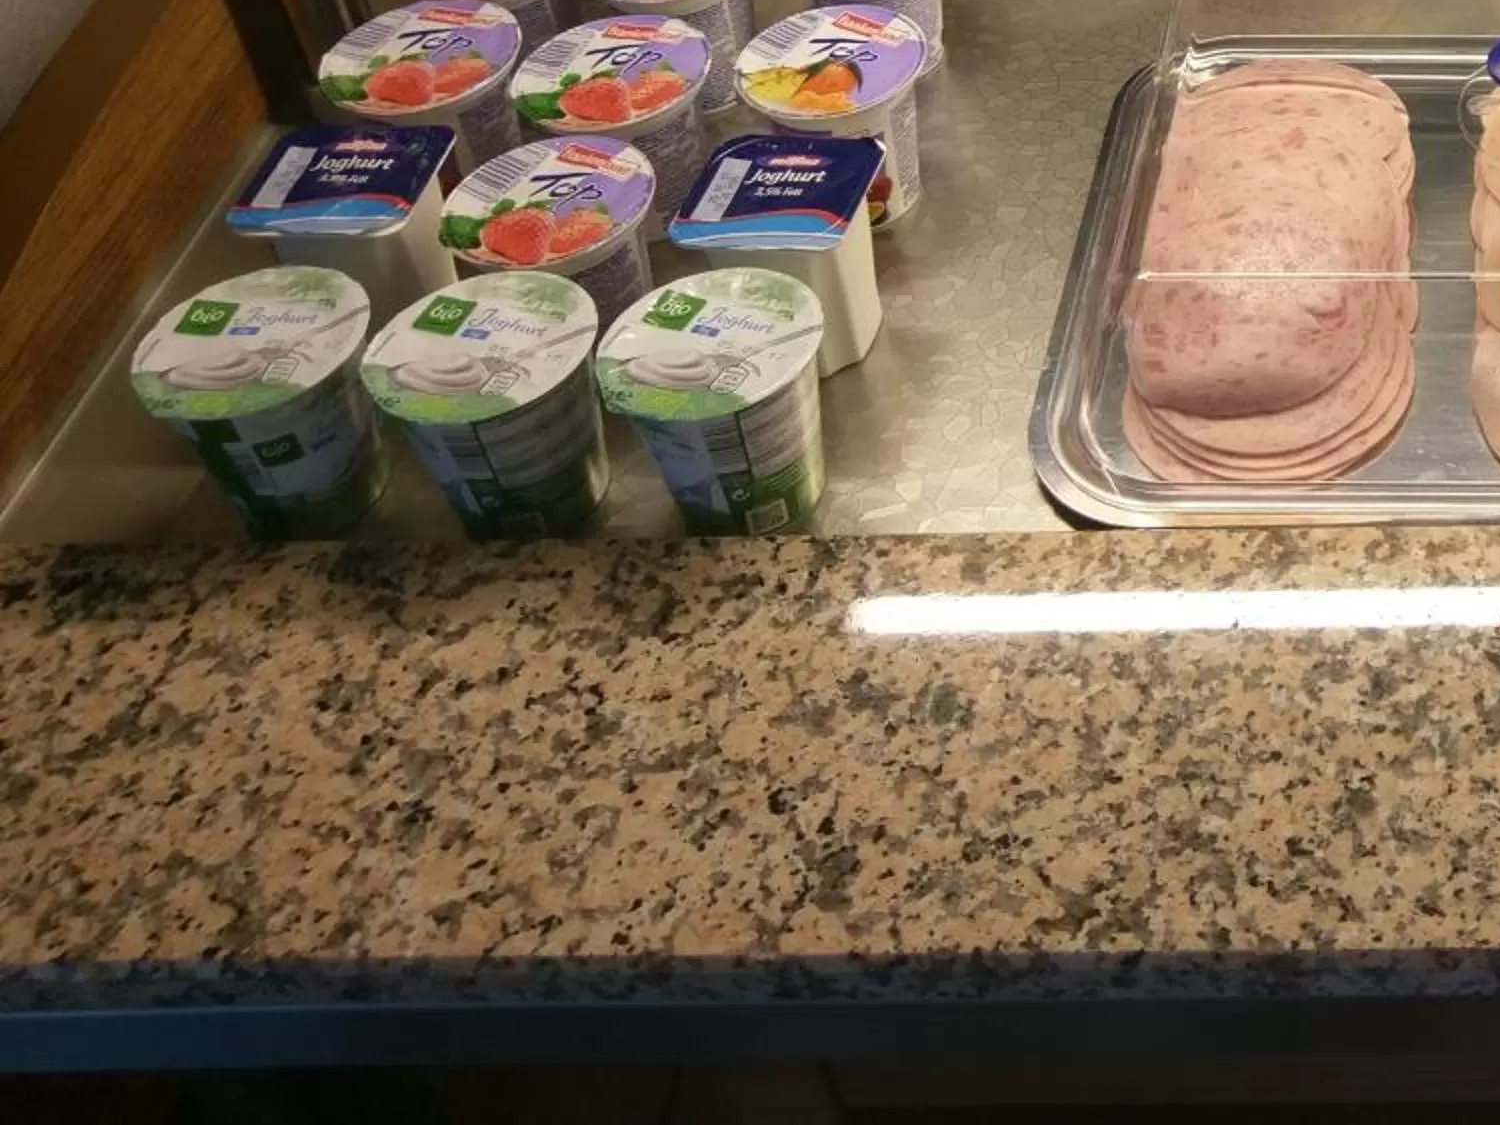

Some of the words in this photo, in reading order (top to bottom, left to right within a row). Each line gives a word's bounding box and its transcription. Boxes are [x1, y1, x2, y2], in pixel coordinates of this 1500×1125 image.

[398, 28, 473, 58] Top
[809, 38, 879, 63] Top
[586, 43, 663, 74] Top
[310, 154, 395, 172] Joghurt
[745, 168, 827, 185] Joghurt
[529, 172, 603, 209] Top
[190, 307, 226, 324] bio
[233, 306, 319, 326] Joghurt
[430, 302, 463, 322] bio
[468, 307, 548, 338] Joghurt
[660, 297, 692, 316] bio
[698, 306, 776, 335] Joghurt
